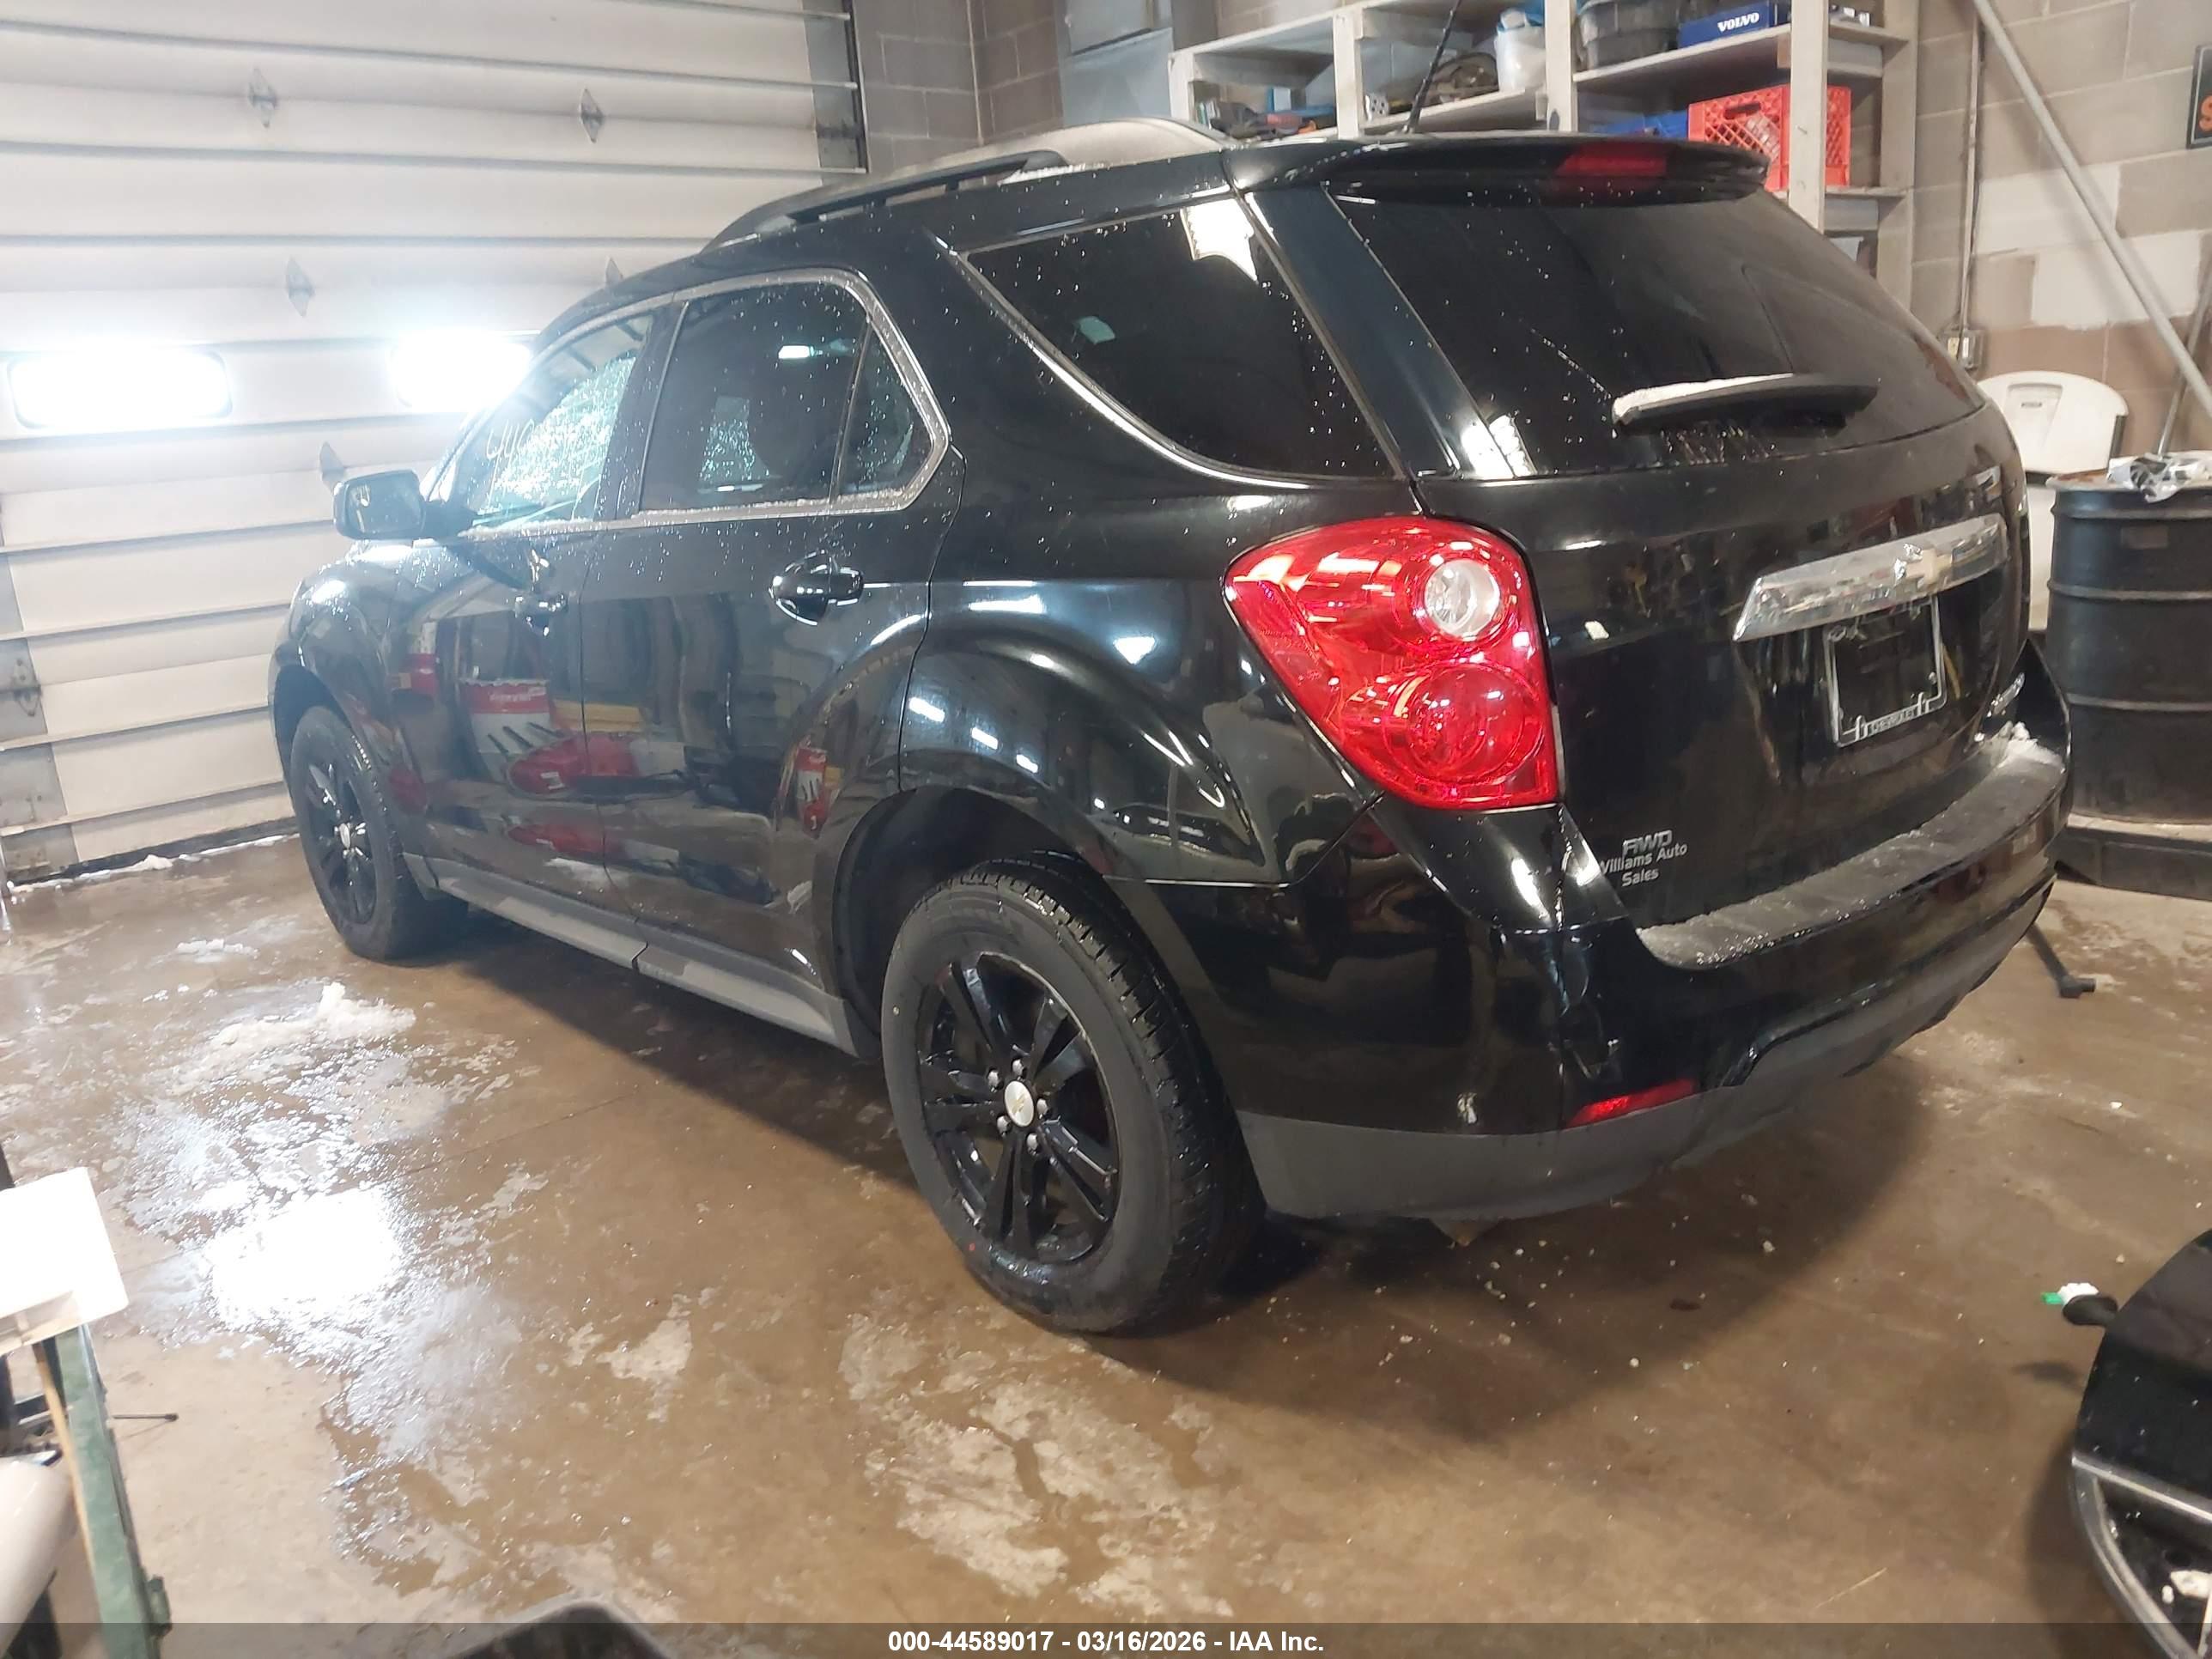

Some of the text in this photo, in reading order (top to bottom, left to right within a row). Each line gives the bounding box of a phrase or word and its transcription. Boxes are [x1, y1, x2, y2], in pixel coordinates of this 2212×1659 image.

[1717, 12, 1760, 33] VOLVO
[1599, 842, 1688, 875] Williams Auto
[1621, 867, 1659, 887] Sales
